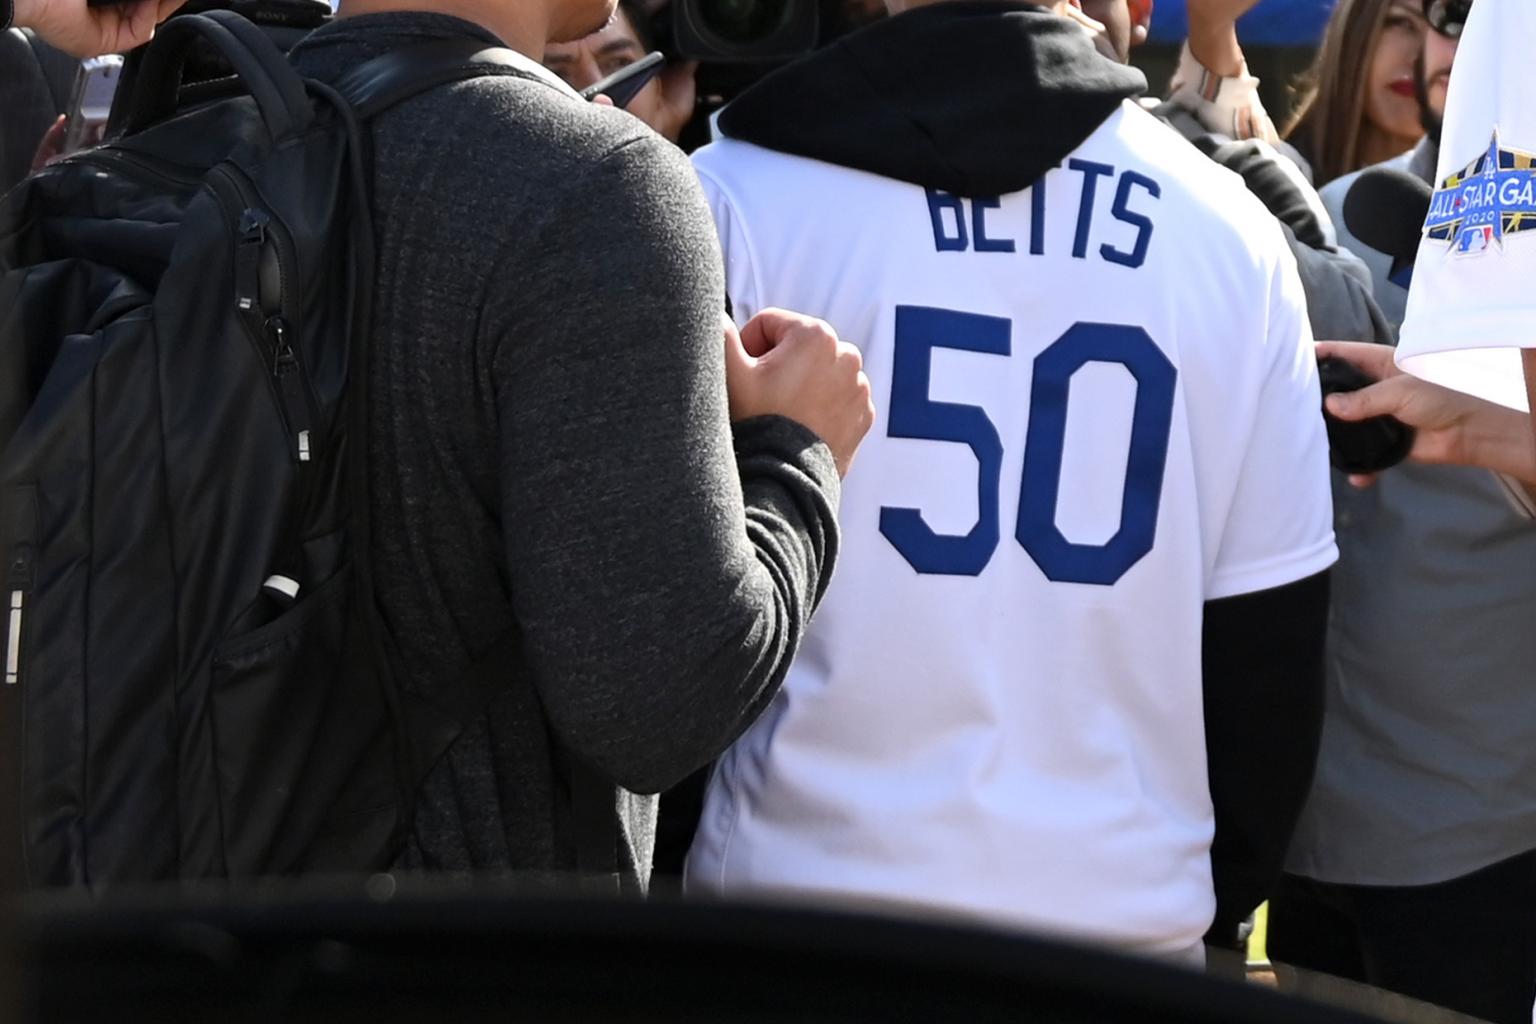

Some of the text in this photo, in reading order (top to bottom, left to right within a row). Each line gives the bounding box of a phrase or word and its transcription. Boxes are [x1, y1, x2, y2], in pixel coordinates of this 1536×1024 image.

[926, 158, 1161, 269] BETTS
[1459, 181, 1497, 213] STAR
[879, 304, 1178, 586] 50
